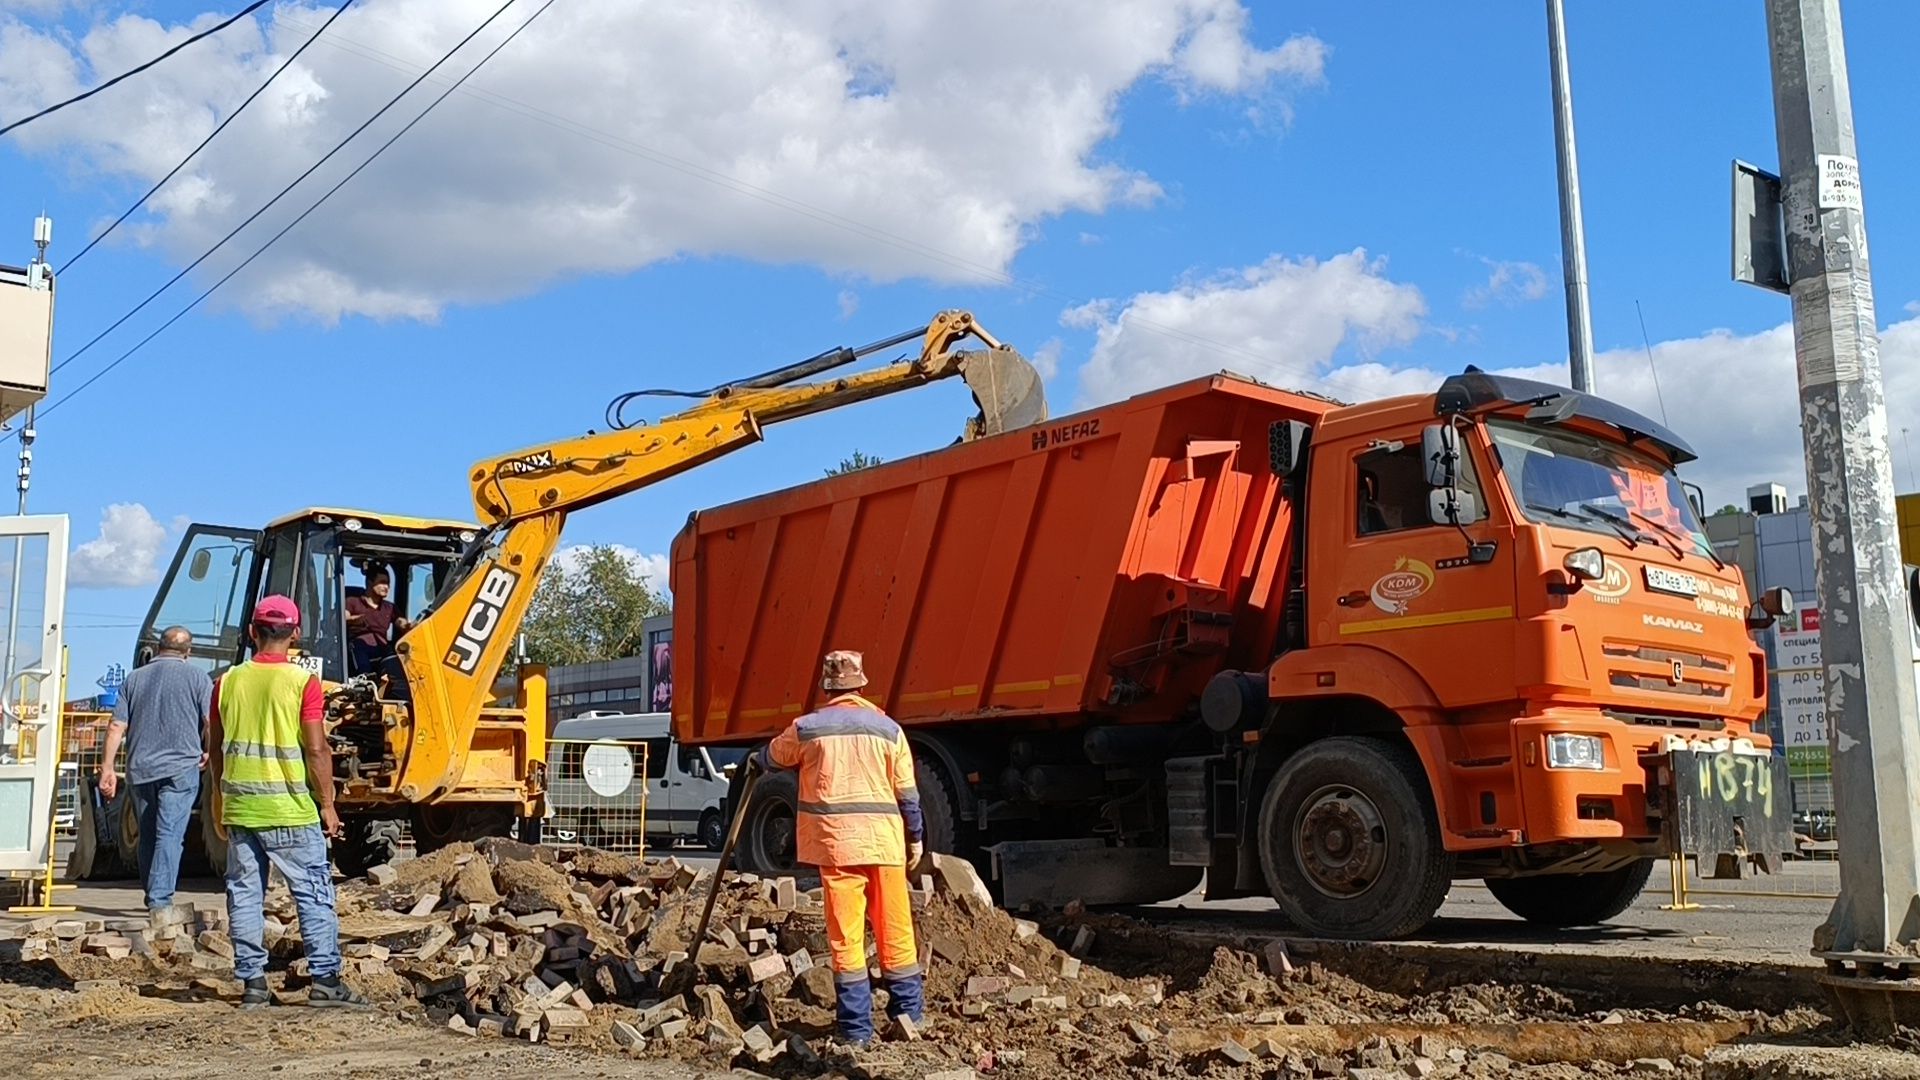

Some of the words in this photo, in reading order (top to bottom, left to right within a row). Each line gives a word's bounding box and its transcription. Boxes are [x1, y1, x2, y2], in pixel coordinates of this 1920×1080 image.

[1051, 419, 1100, 444] NEFAZ
[454, 568, 516, 670] JCB
[1642, 614, 1703, 633] KAMAZ
